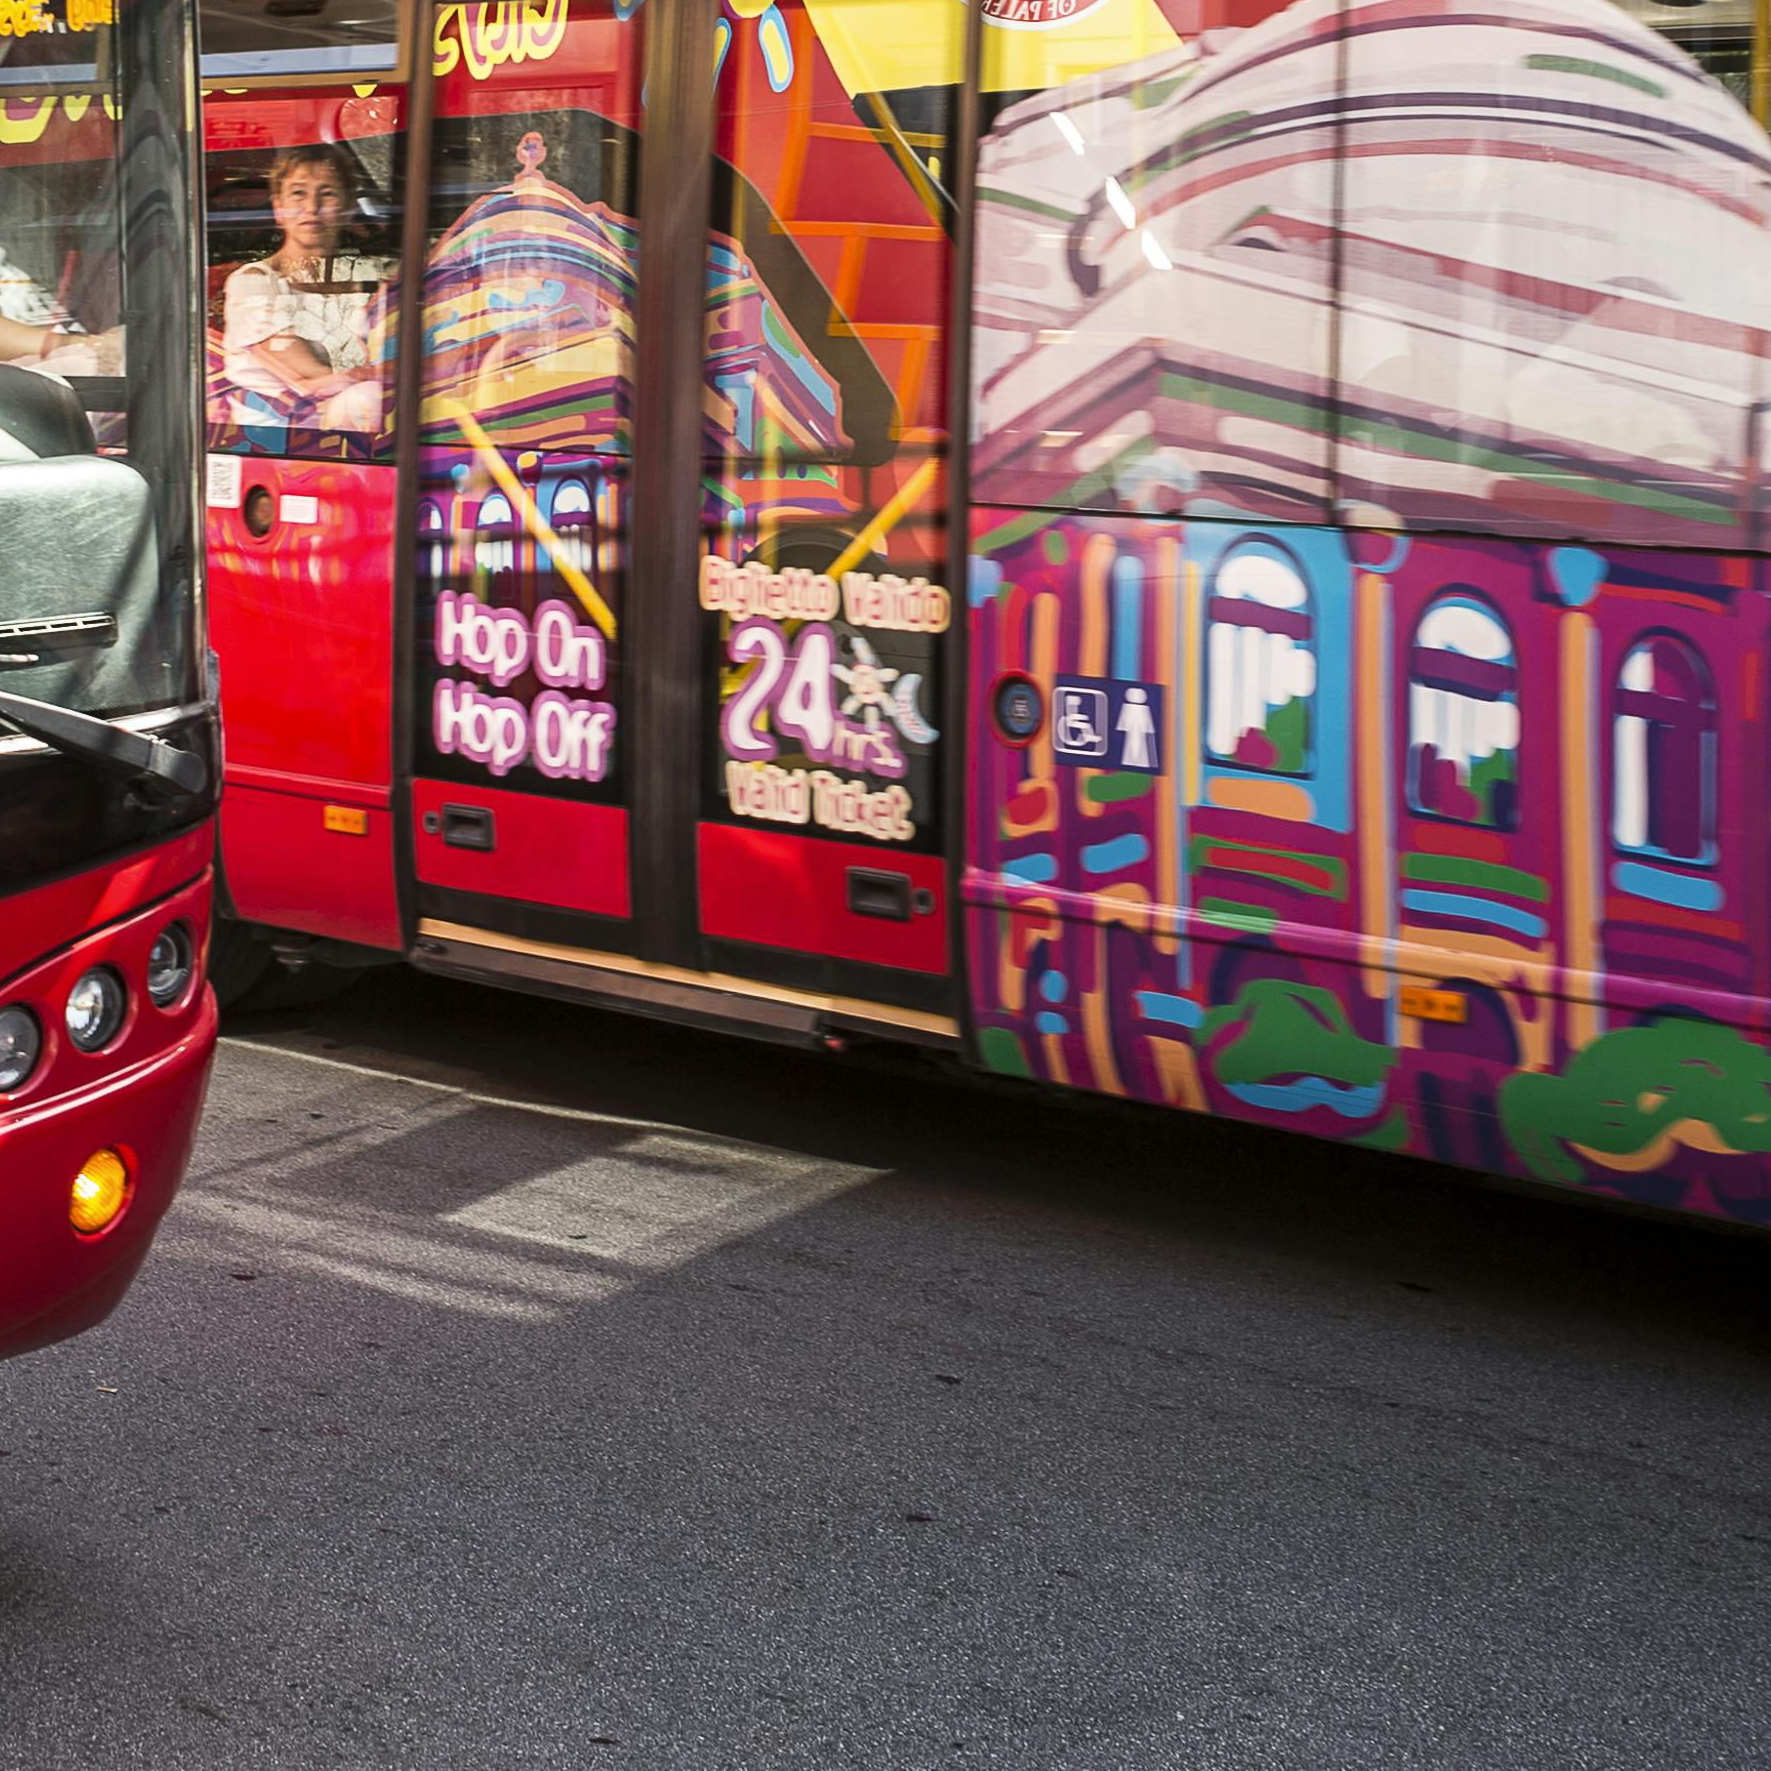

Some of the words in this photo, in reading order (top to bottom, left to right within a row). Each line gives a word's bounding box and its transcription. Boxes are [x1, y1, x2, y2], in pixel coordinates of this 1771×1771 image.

[436, 589, 532, 687] Hop
[534, 599, 605, 690] On
[700, 557, 840, 620] Biglietto
[843, 571, 950, 633] Valido
[435, 677, 530, 775] Hop
[534, 687, 616, 782] Off
[721, 623, 833, 760] 24
[725, 760, 813, 821] Valid
[813, 771, 913, 840] Ticket
